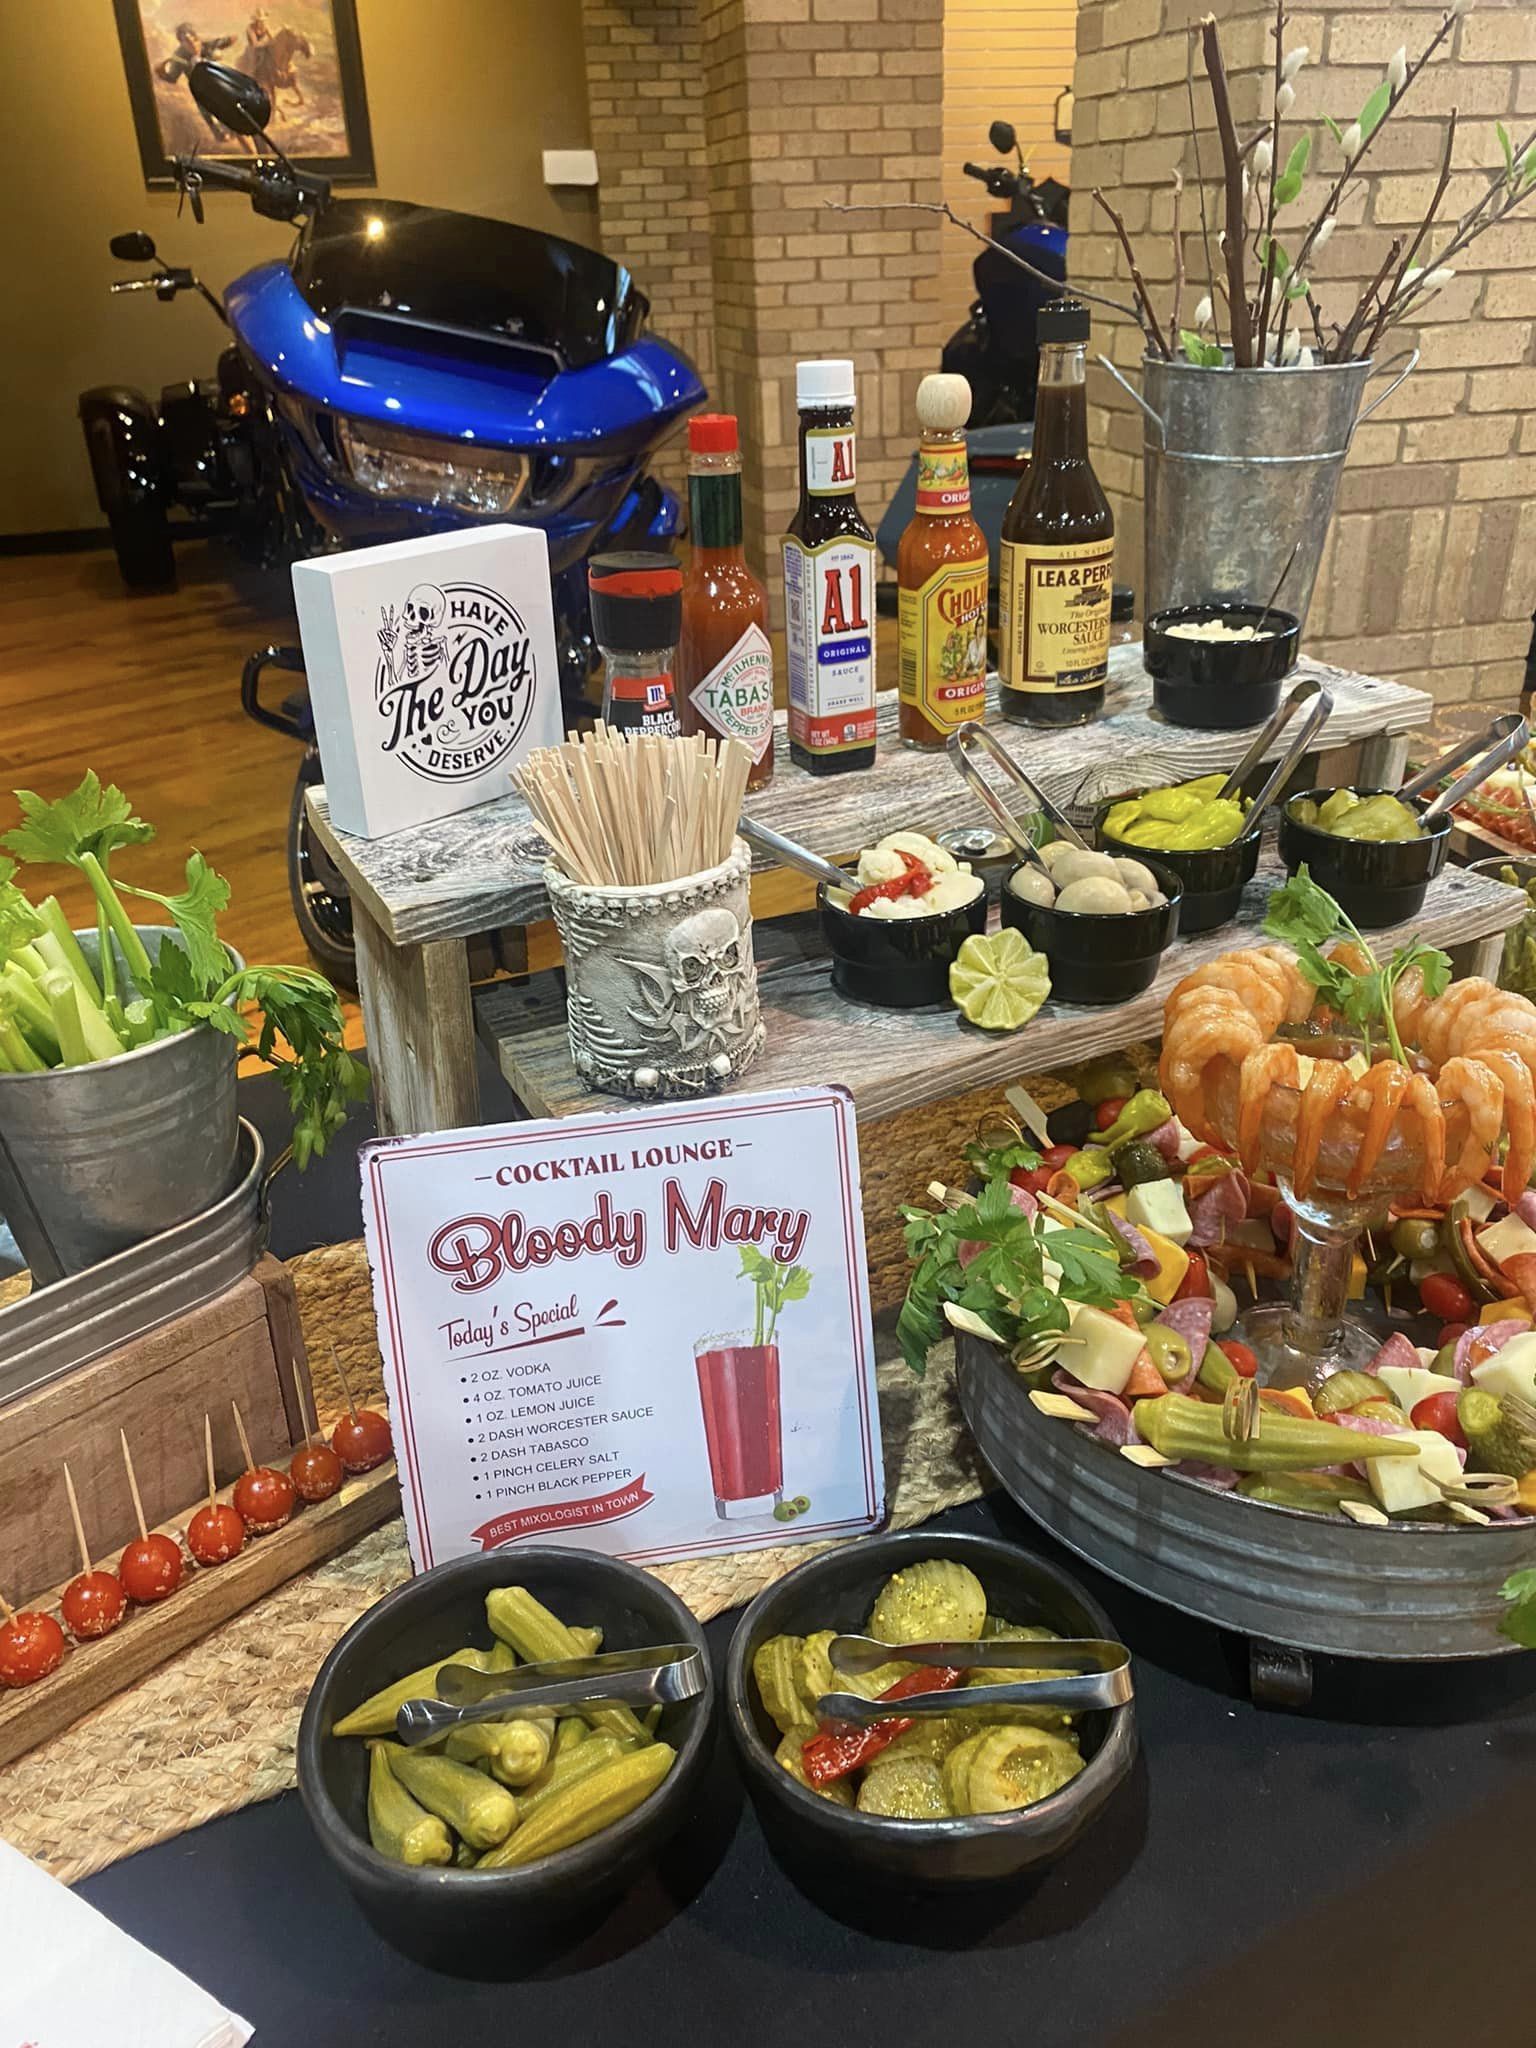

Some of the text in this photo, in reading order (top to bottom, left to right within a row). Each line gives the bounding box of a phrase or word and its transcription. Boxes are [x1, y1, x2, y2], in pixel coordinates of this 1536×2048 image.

[941, 491, 970, 504] ORIG
[1037, 562, 1112, 588] LEA & PERR
[451, 600, 509, 636] HAVE
[823, 645, 867, 658] ORIGINAL
[1072, 629, 1104, 646] SAUCE
[832, 666, 860, 677] SAUCE
[379, 637, 531, 752] The Day
[461, 694, 514, 731] YOU
[642, 711, 674, 726] BLACK
[721, 708, 758, 736] PEPPER
[740, 703, 767, 717] BRAND
[427, 730, 507, 771] DESERVE
[496, 1138, 734, 1186] COCKTAIL LOUNGE
[428, 1177, 811, 1294] Bloody Mary
[438, 1293, 580, 1350] Today's Special
[470, 1373, 479, 1383] 2
[506, 1362, 551, 1378] VODKA
[473, 1394, 480, 1403] 4
[508, 1381, 563, 1399] TOMATO
[566, 1374, 602, 1390] JUICE
[476, 1414, 482, 1423] 1
[511, 1403, 556, 1418] LEMON
[559, 1396, 595, 1411] JUICE
[478, 1406, 655, 1443] 2 DASH WORCESTER SAUCE
[480, 1436, 590, 1462] 2 DASH TABASCO
[484, 1451, 620, 1481] 1 PINCH CELERY SALT
[486, 1468, 632, 1499] 1 PINCH BLACK PEPPER
[489, 1491, 639, 1538] BEST MIXOLOGIST IN TOWN
